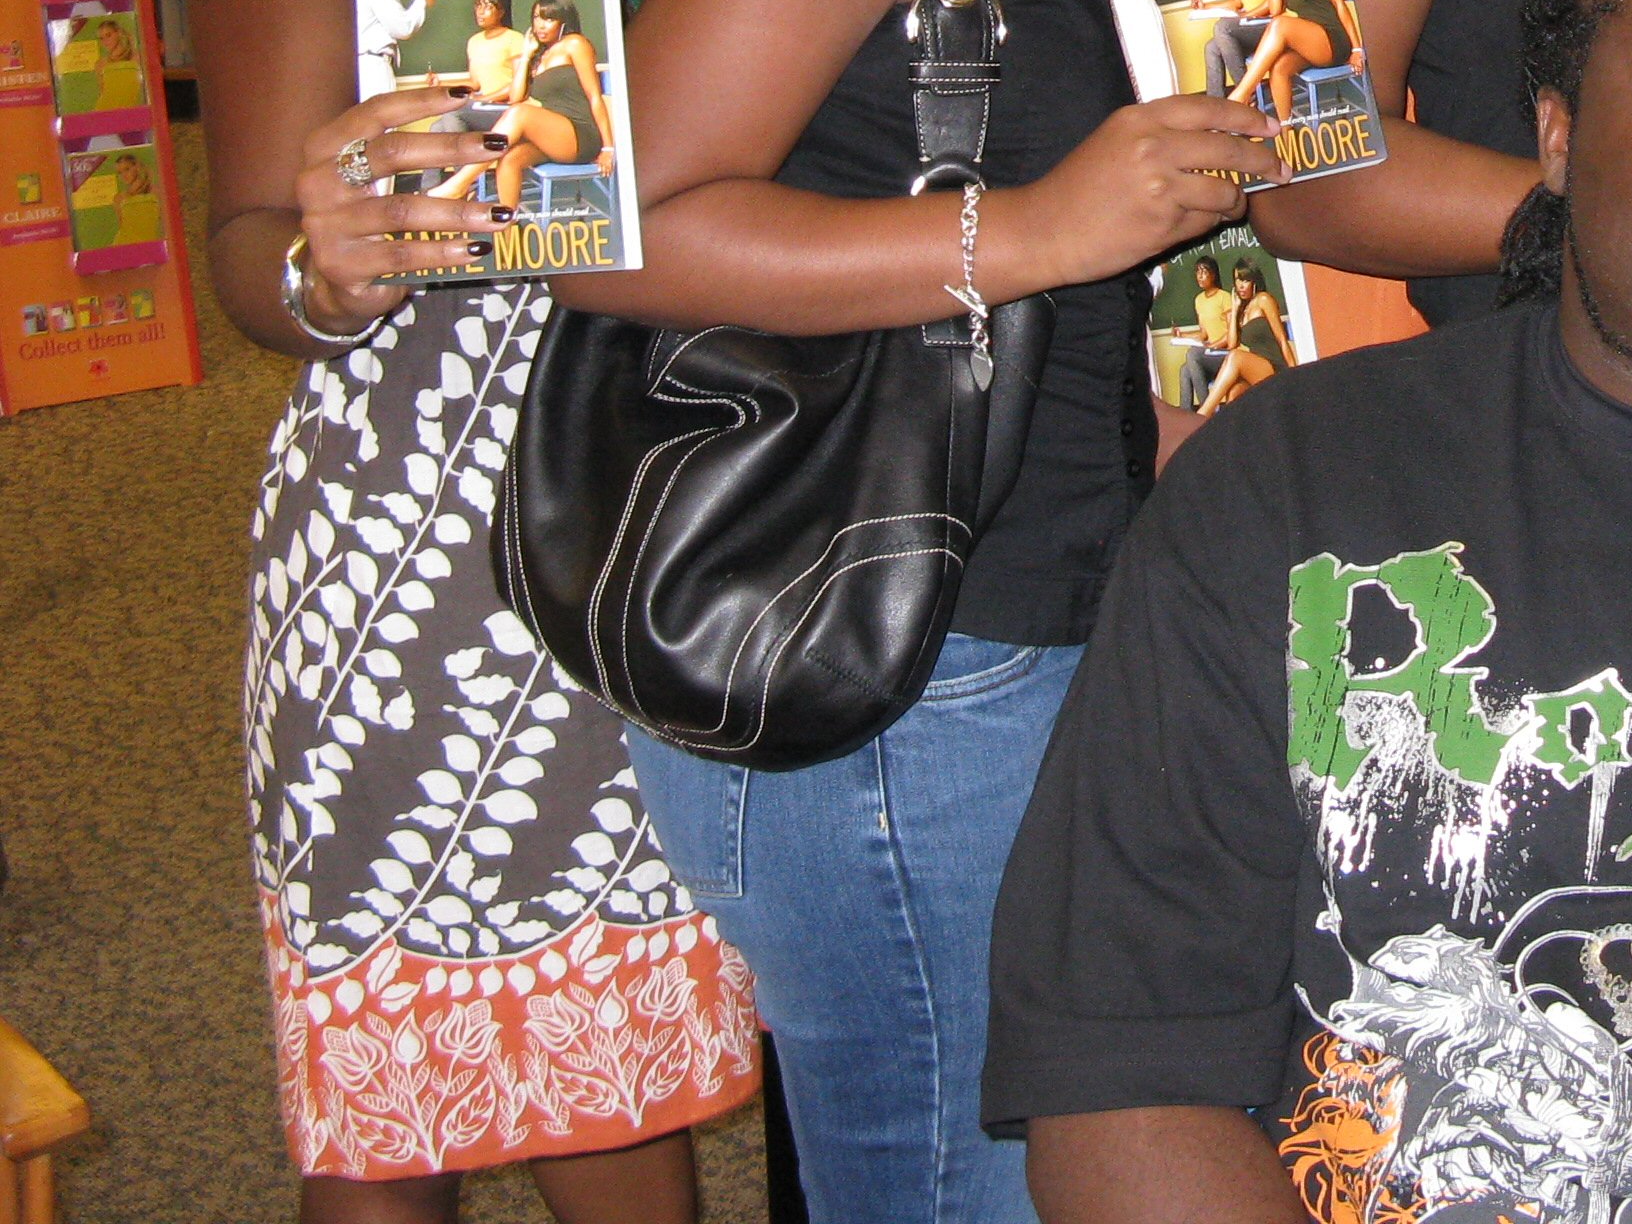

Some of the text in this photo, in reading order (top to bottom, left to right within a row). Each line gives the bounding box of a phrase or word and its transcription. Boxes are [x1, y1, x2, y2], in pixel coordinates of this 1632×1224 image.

[1274, 114, 1376, 171] MOORE
[5, 207, 61, 223] CLAIRE
[493, 219, 614, 271] MOORE
[19, 324, 166, 360] Collect them all!
